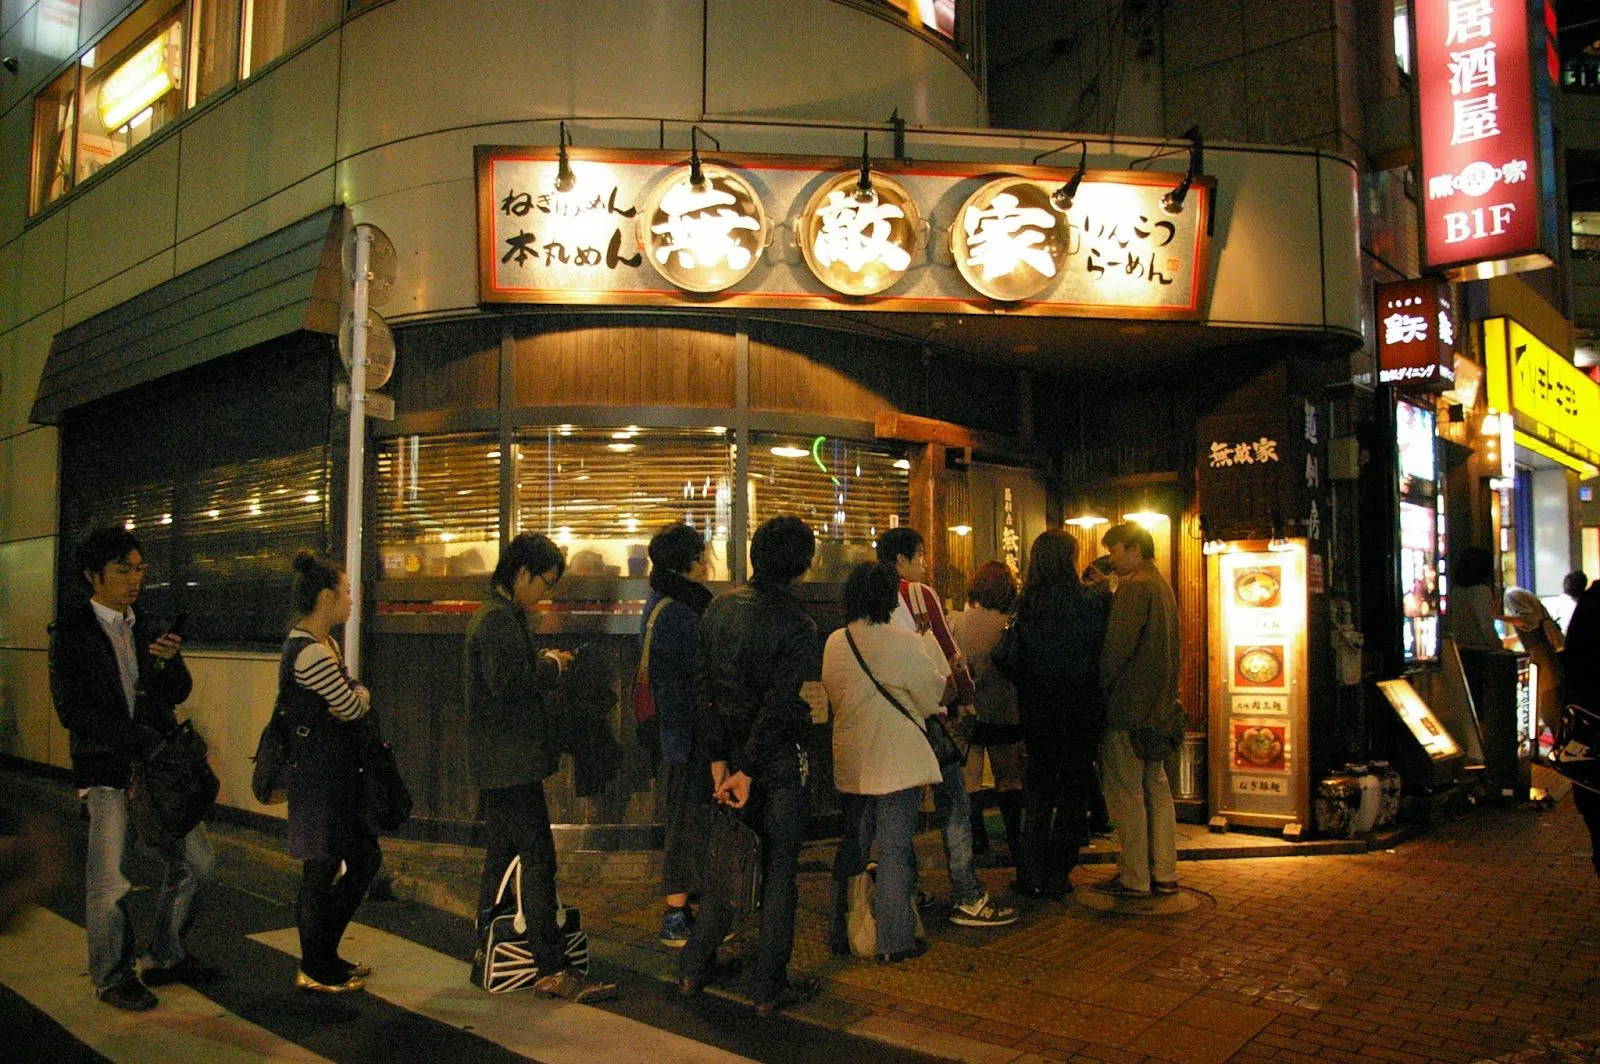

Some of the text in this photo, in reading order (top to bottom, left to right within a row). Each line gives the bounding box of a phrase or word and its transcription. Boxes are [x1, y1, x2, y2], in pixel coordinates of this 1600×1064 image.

[1446, 0, 1501, 146] 居酒屋
[1443, 203, 1516, 244] B1F
[501, 228, 642, 269] 本丸めん
[1087, 249, 1173, 285] らーめん
[1208, 437, 1279, 468] 無敵家
